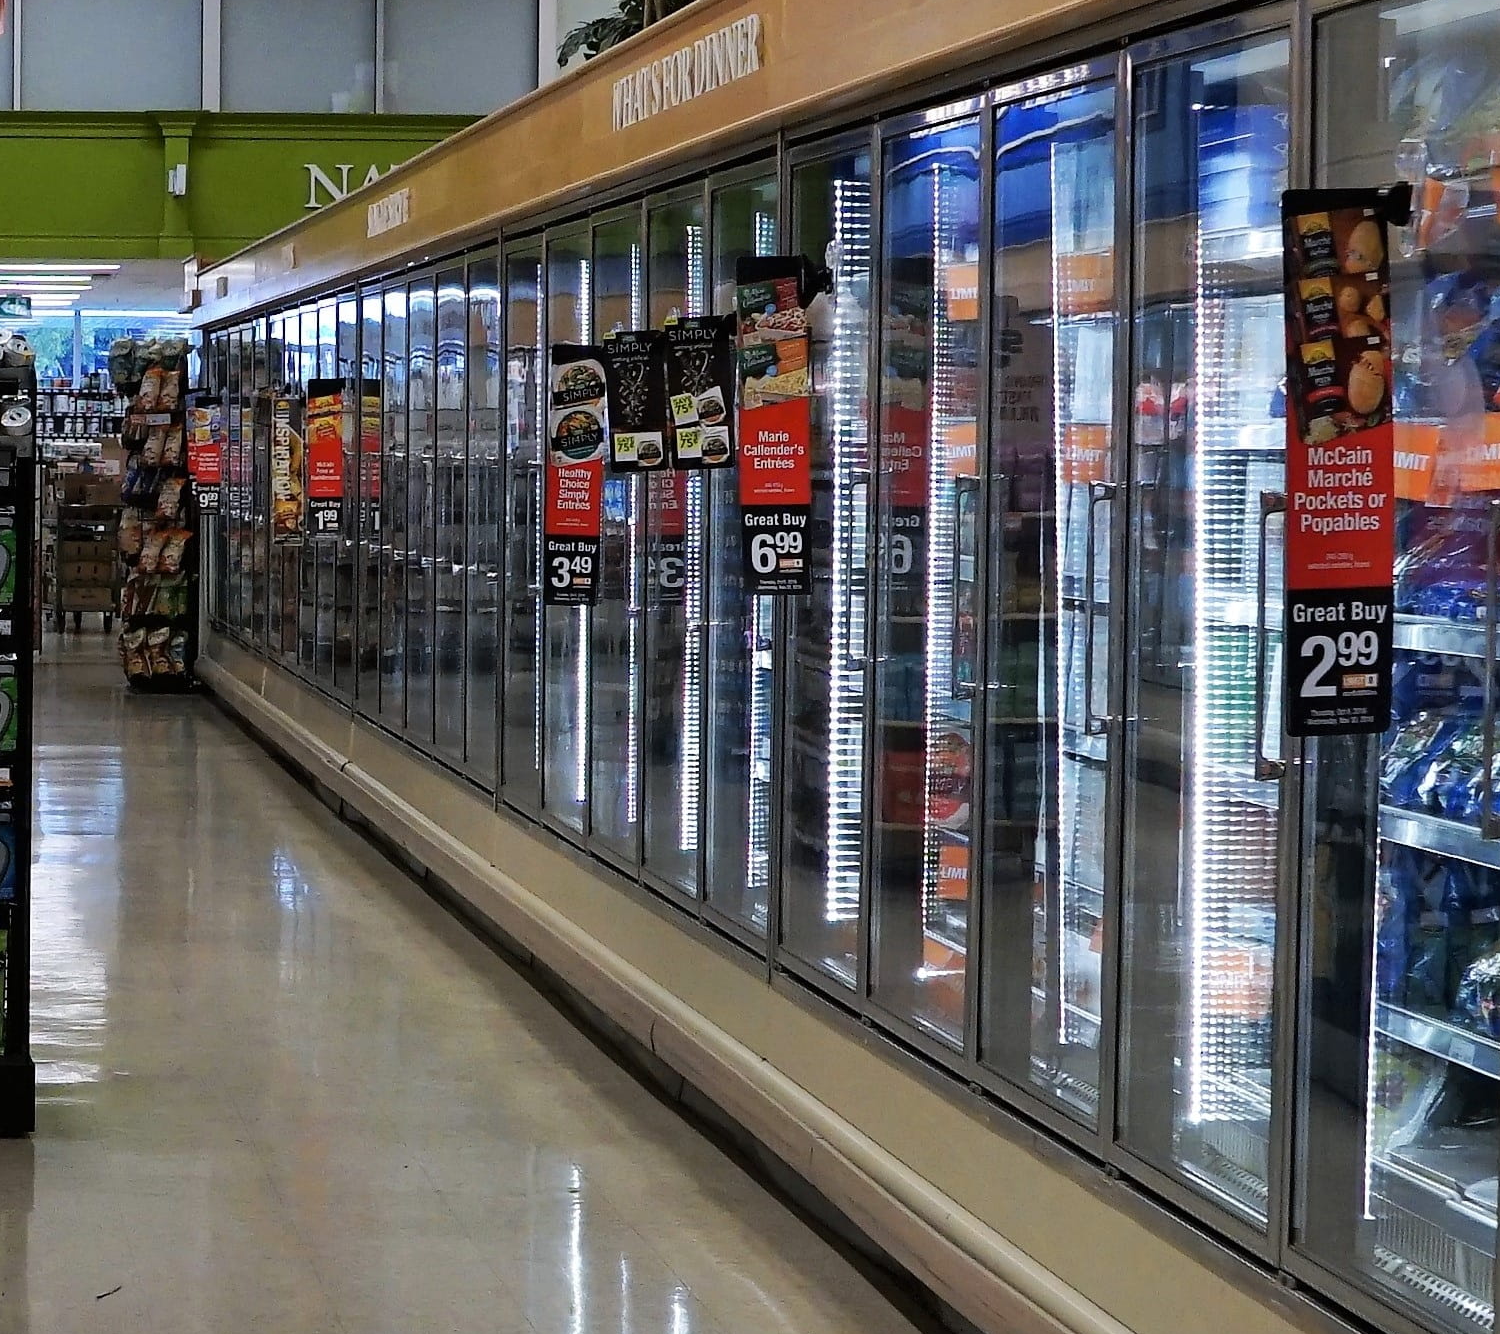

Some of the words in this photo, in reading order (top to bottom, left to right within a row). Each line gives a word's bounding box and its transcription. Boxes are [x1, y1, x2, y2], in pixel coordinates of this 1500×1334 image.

[613, 62, 661, 132] WHAT'S
[662, 48, 692, 110] FOR
[693, 13, 761, 98] DINNER
[669, 329, 717, 341] SIMPLY
[607, 342, 652, 354] SIMPLY
[563, 387, 599, 402] SIMPLY
[758, 431, 789, 443] Marie
[743, 443, 804, 456] Callender's
[754, 456, 795, 469] Entrées
[1308, 446, 1373, 467] McCain
[1394, 452, 1430, 471] IMIT
[558, 468, 592, 480] Healthy
[1308, 467, 1374, 489] Marché
[559, 478, 590, 489] Choice
[558, 489, 590, 502] Simply
[1294, 491, 1364, 512] Pockets
[1367, 495, 1387, 511] or
[557, 499, 591, 510] Entrées
[745, 514, 779, 528] Great
[782, 514, 807, 529] Buy
[1300, 511, 1380, 535] Popables
[548, 541, 573, 553] Great
[575, 542, 597, 554] Buy
[1293, 603, 1346, 623] Great
[1351, 602, 1387, 624] Buy
